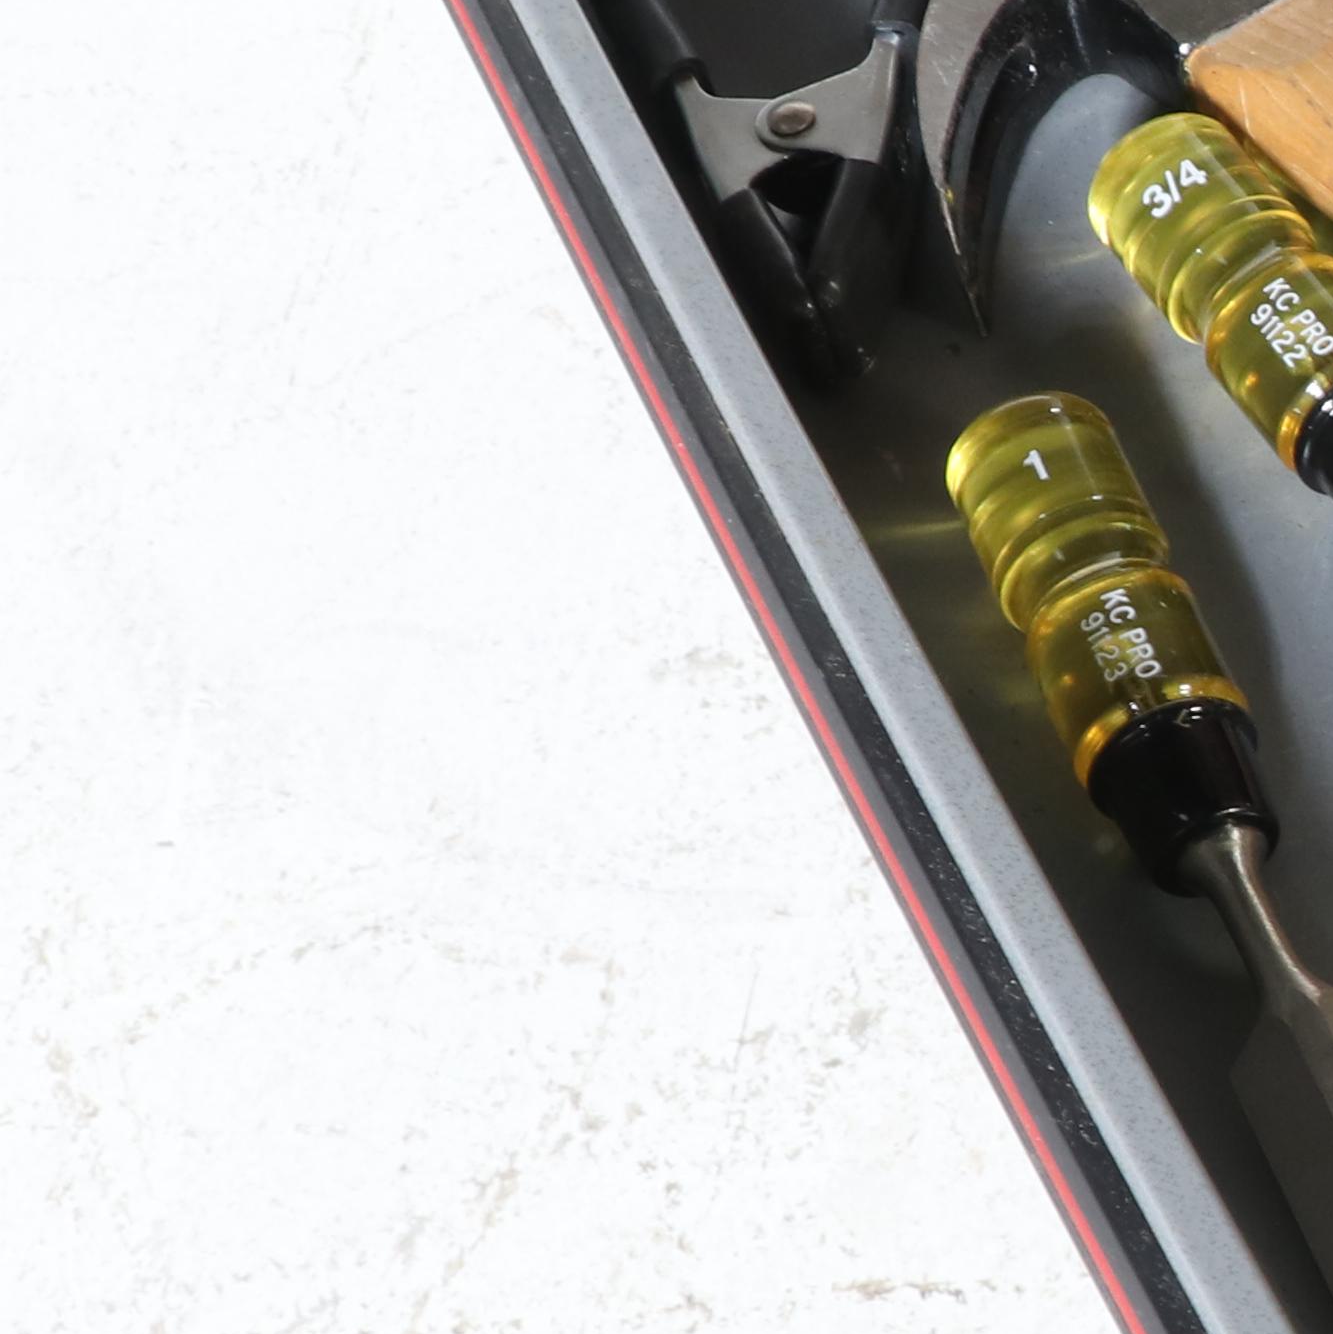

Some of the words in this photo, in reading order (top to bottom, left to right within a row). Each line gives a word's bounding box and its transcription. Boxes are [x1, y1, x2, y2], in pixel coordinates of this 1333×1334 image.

[1141, 158, 1208, 219] 3/4
[1261, 277, 1300, 312] KC
[1249, 303, 1309, 371] 91122
[1022, 448, 1050, 481] 1
[1080, 610, 1128, 682] 91123
[1099, 587, 1137, 625] KC
[1119, 626, 1163, 679] PRO
